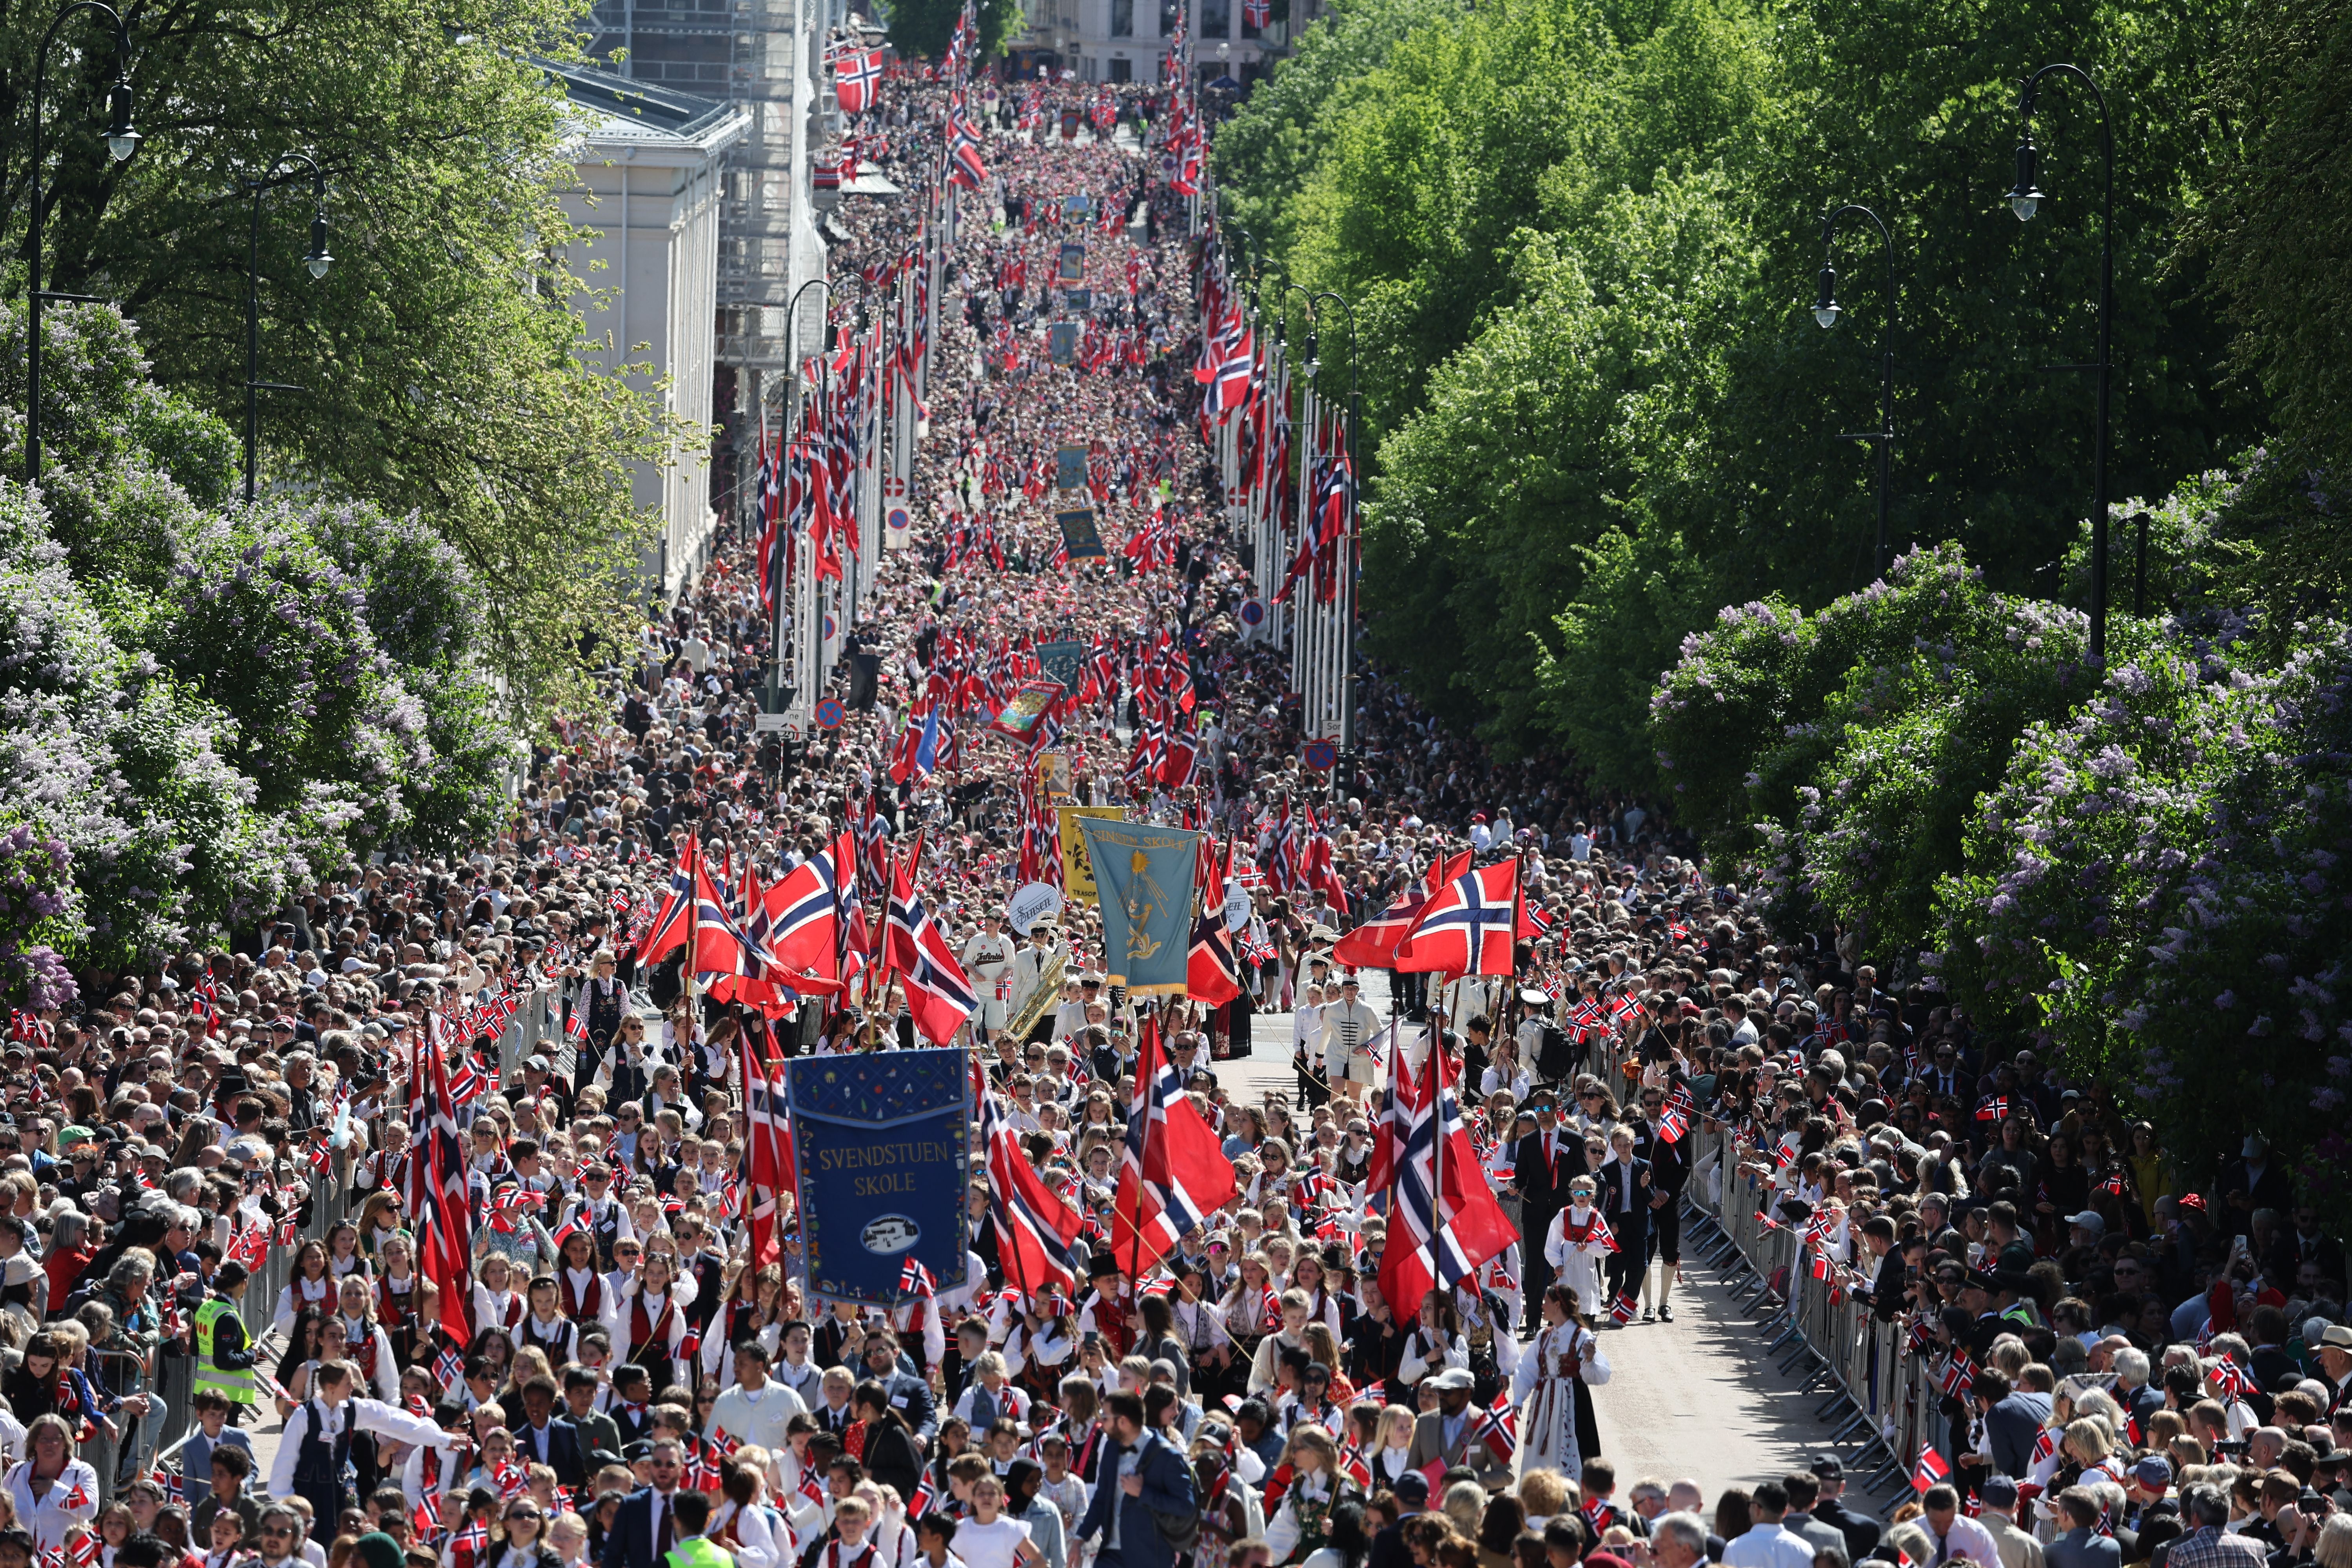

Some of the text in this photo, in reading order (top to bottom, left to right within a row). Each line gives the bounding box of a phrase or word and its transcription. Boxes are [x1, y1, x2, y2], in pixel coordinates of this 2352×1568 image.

[1093, 830, 1186, 851] SINSEN SKOLE
[1016, 898, 1051, 927] Sinsen
[819, 1142, 948, 1170] SVENDSTUEN
[855, 1172, 916, 1196] SKOLE
